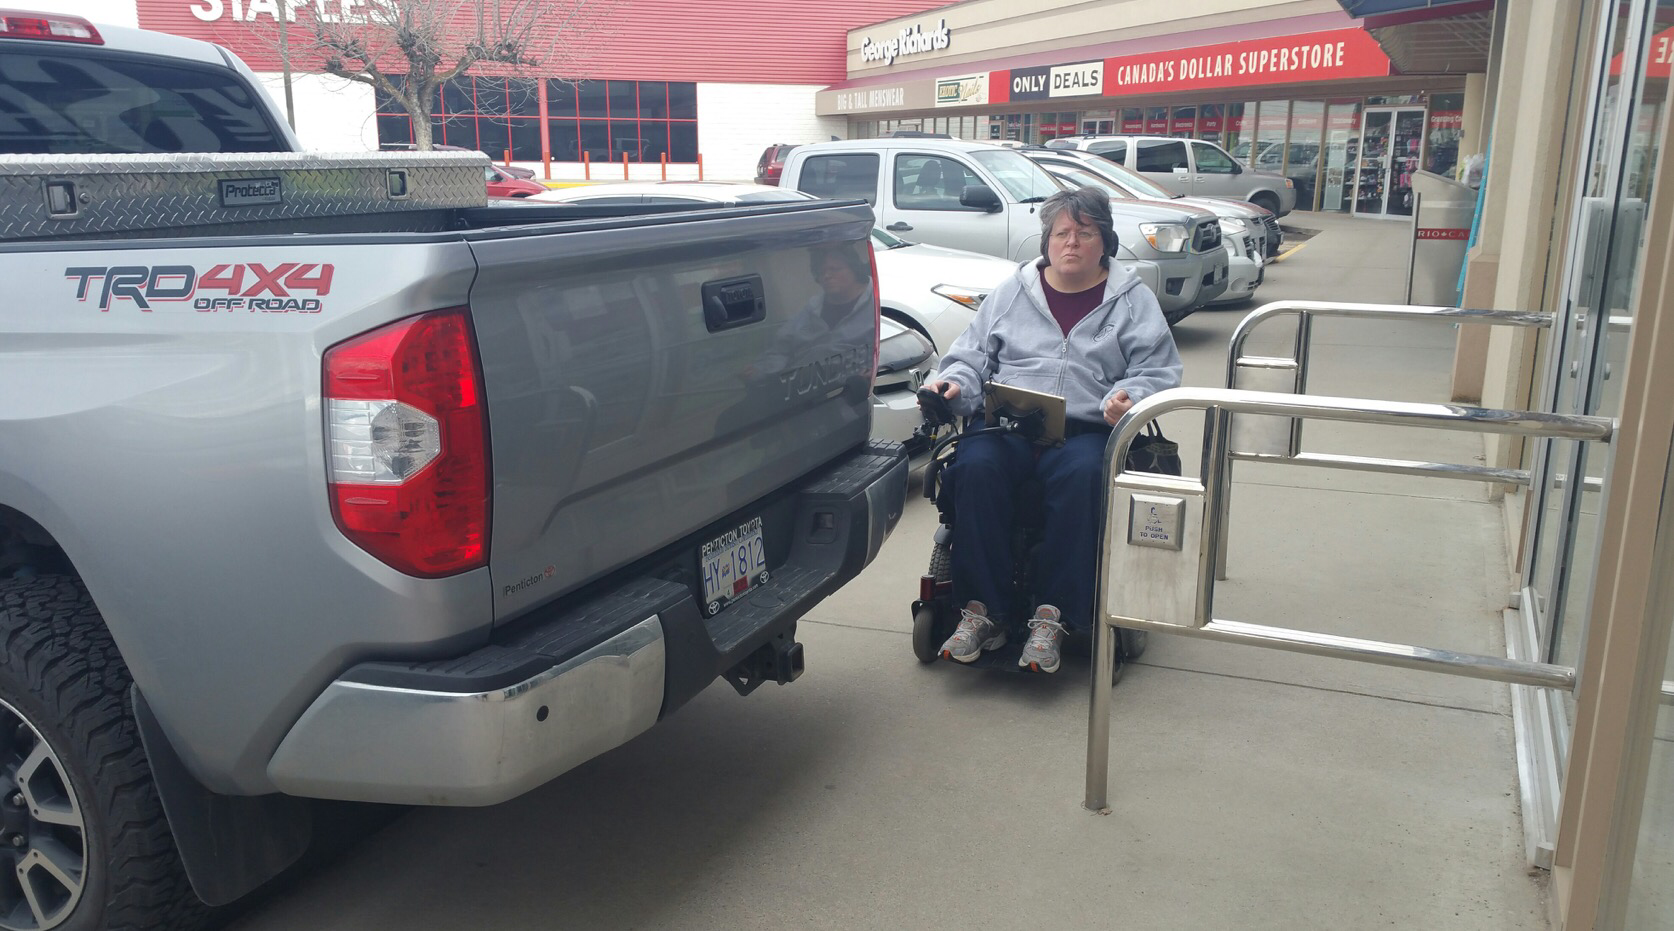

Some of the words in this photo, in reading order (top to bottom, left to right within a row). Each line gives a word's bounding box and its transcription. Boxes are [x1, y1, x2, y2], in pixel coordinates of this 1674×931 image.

[861, 36, 899, 65] George
[899, 19, 950, 56] Richards
[1117, 60, 1175, 86] CANADA'S
[1179, 53, 1233, 81] DOLLAR
[1238, 41, 1346, 75] SUPERSTORE
[1013, 74, 1047, 93] ONLY
[1053, 69, 1099, 90] DEALS
[837, 94, 849, 111] BIG
[848, 93, 854, 110] &
[854, 91, 868, 110] TALL
[868, 87, 905, 109] MENSWEAR
[1417, 230, 1440, 238] RIO
[1448, 230, 1470, 238] CA
[64, 264, 199, 312] TRD
[197, 262, 335, 297] 4X4
[193, 297, 246, 313] OFF
[247, 297, 323, 314] ROAD
[702, 528, 738, 558] PENTICTON
[739, 515, 763, 537] TOYOTA
[703, 558, 721, 599] HY
[730, 536, 766, 581] 1812
[505, 573, 544, 597] Penticton
